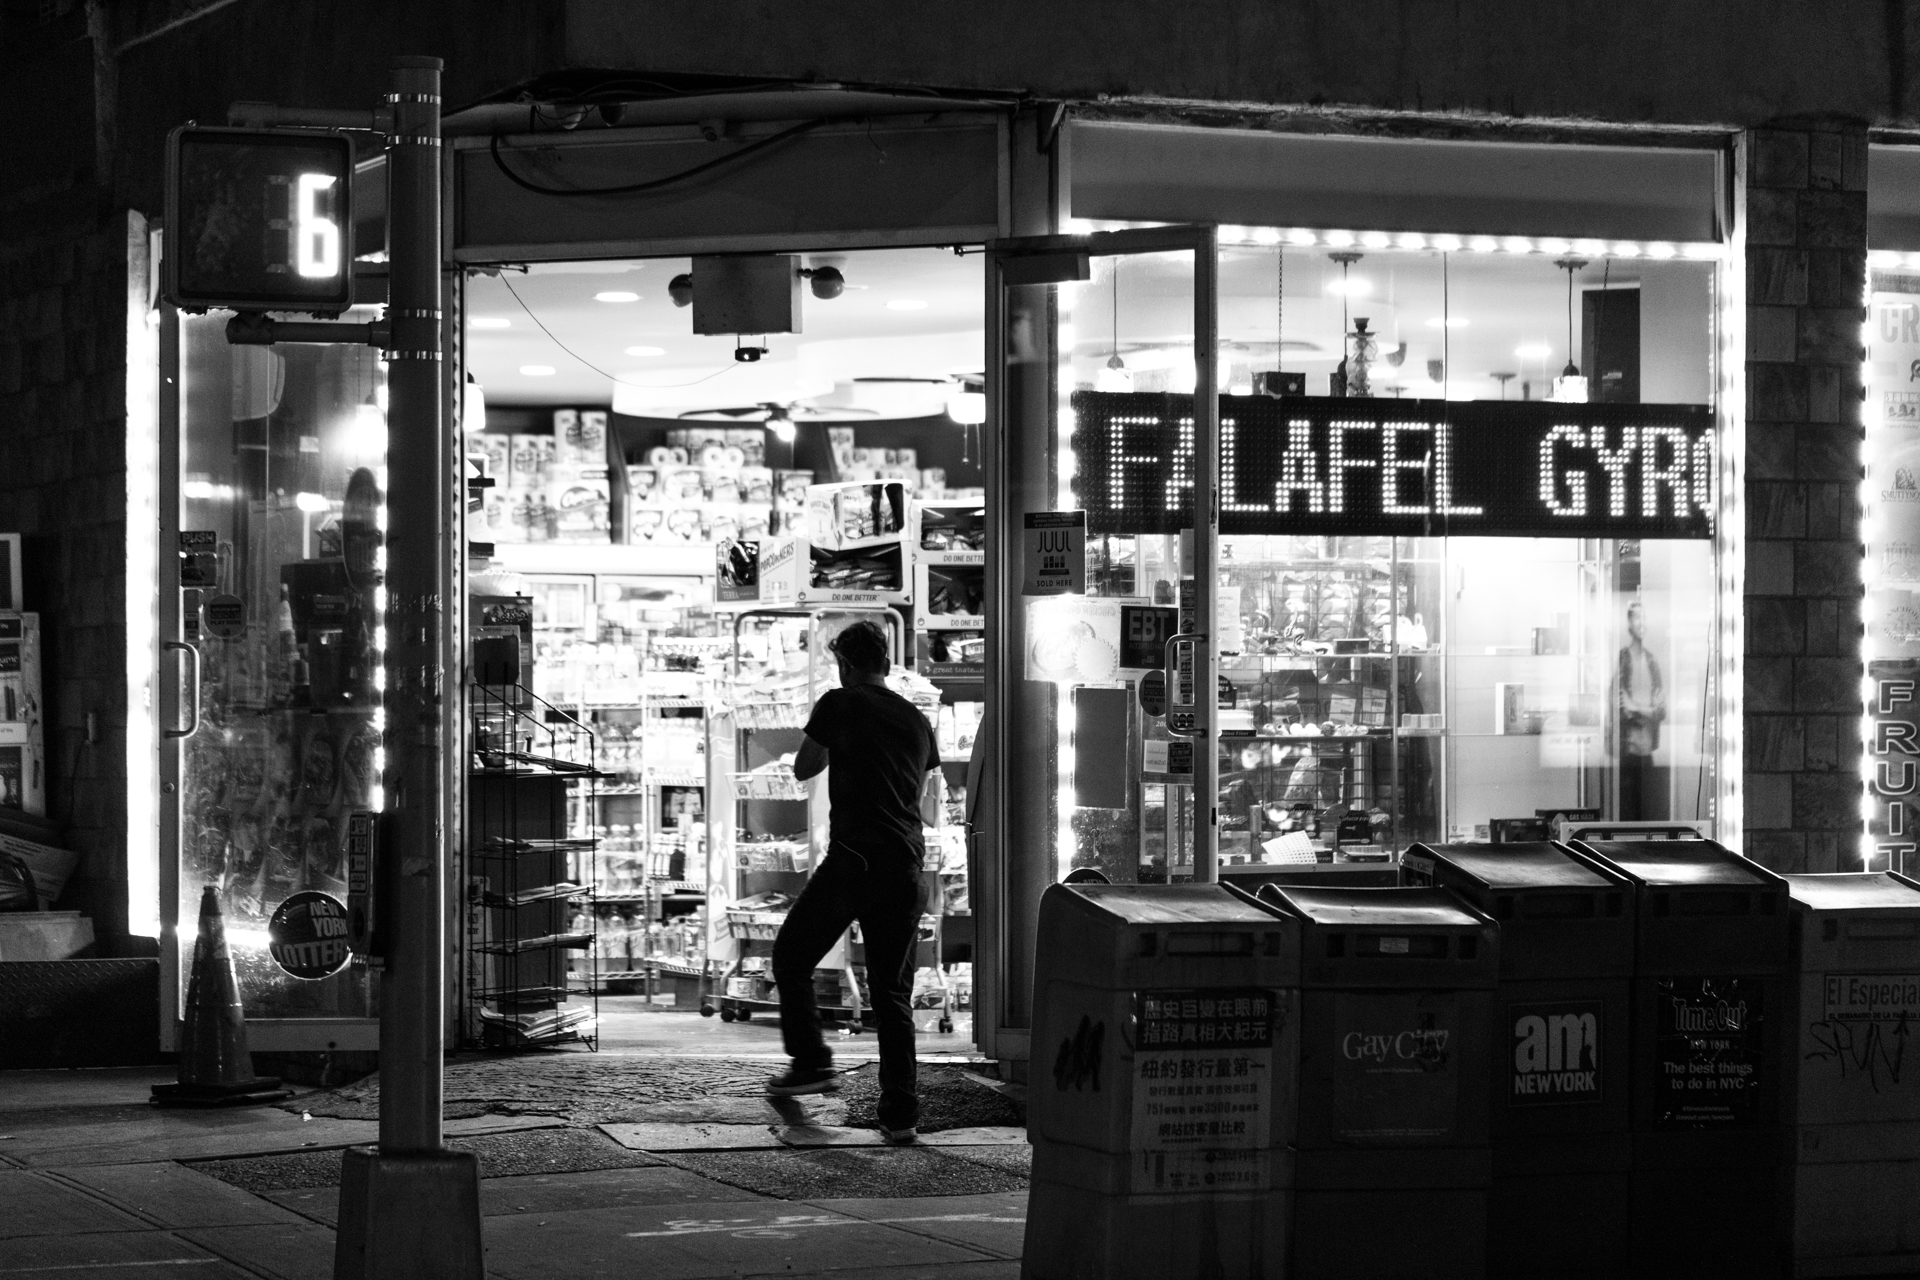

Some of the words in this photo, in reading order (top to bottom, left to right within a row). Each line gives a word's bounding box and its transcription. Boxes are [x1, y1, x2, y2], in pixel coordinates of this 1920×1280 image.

[297, 173, 340, 278] 6
[1110, 418, 1483, 515] FALAFEL
[182, 532, 215, 544] PUSH
[1037, 531, 1072, 553] JUUL
[1056, 579, 1072, 587] HERE
[951, 619, 959, 627] DO
[961, 619, 971, 627] ONE
[1128, 609, 1170, 643] EBT
[1875, 679, 1920, 874] FRUIT
[309, 900, 340, 917] NEW
[275, 937, 348, 969] LOTTER
[1828, 978, 1843, 1006] El
[1849, 977, 1920, 1012] Especia
[1671, 997, 1715, 1032] Time
[1342, 1031, 1394, 1063] Gay
[1514, 1012, 1597, 1074] am
[1514, 1073, 1552, 1095] NEW
[1553, 1070, 1597, 1094] YORK
[1663, 1061, 1687, 1075] The
[1688, 1060, 1716, 1075] best
[1717, 1060, 1754, 1077] things
[1671, 1077, 1686, 1090] to
[1687, 1077, 1703, 1090] do
[1705, 1077, 1718, 1090] in
[1719, 1077, 1746, 1090] NYC
